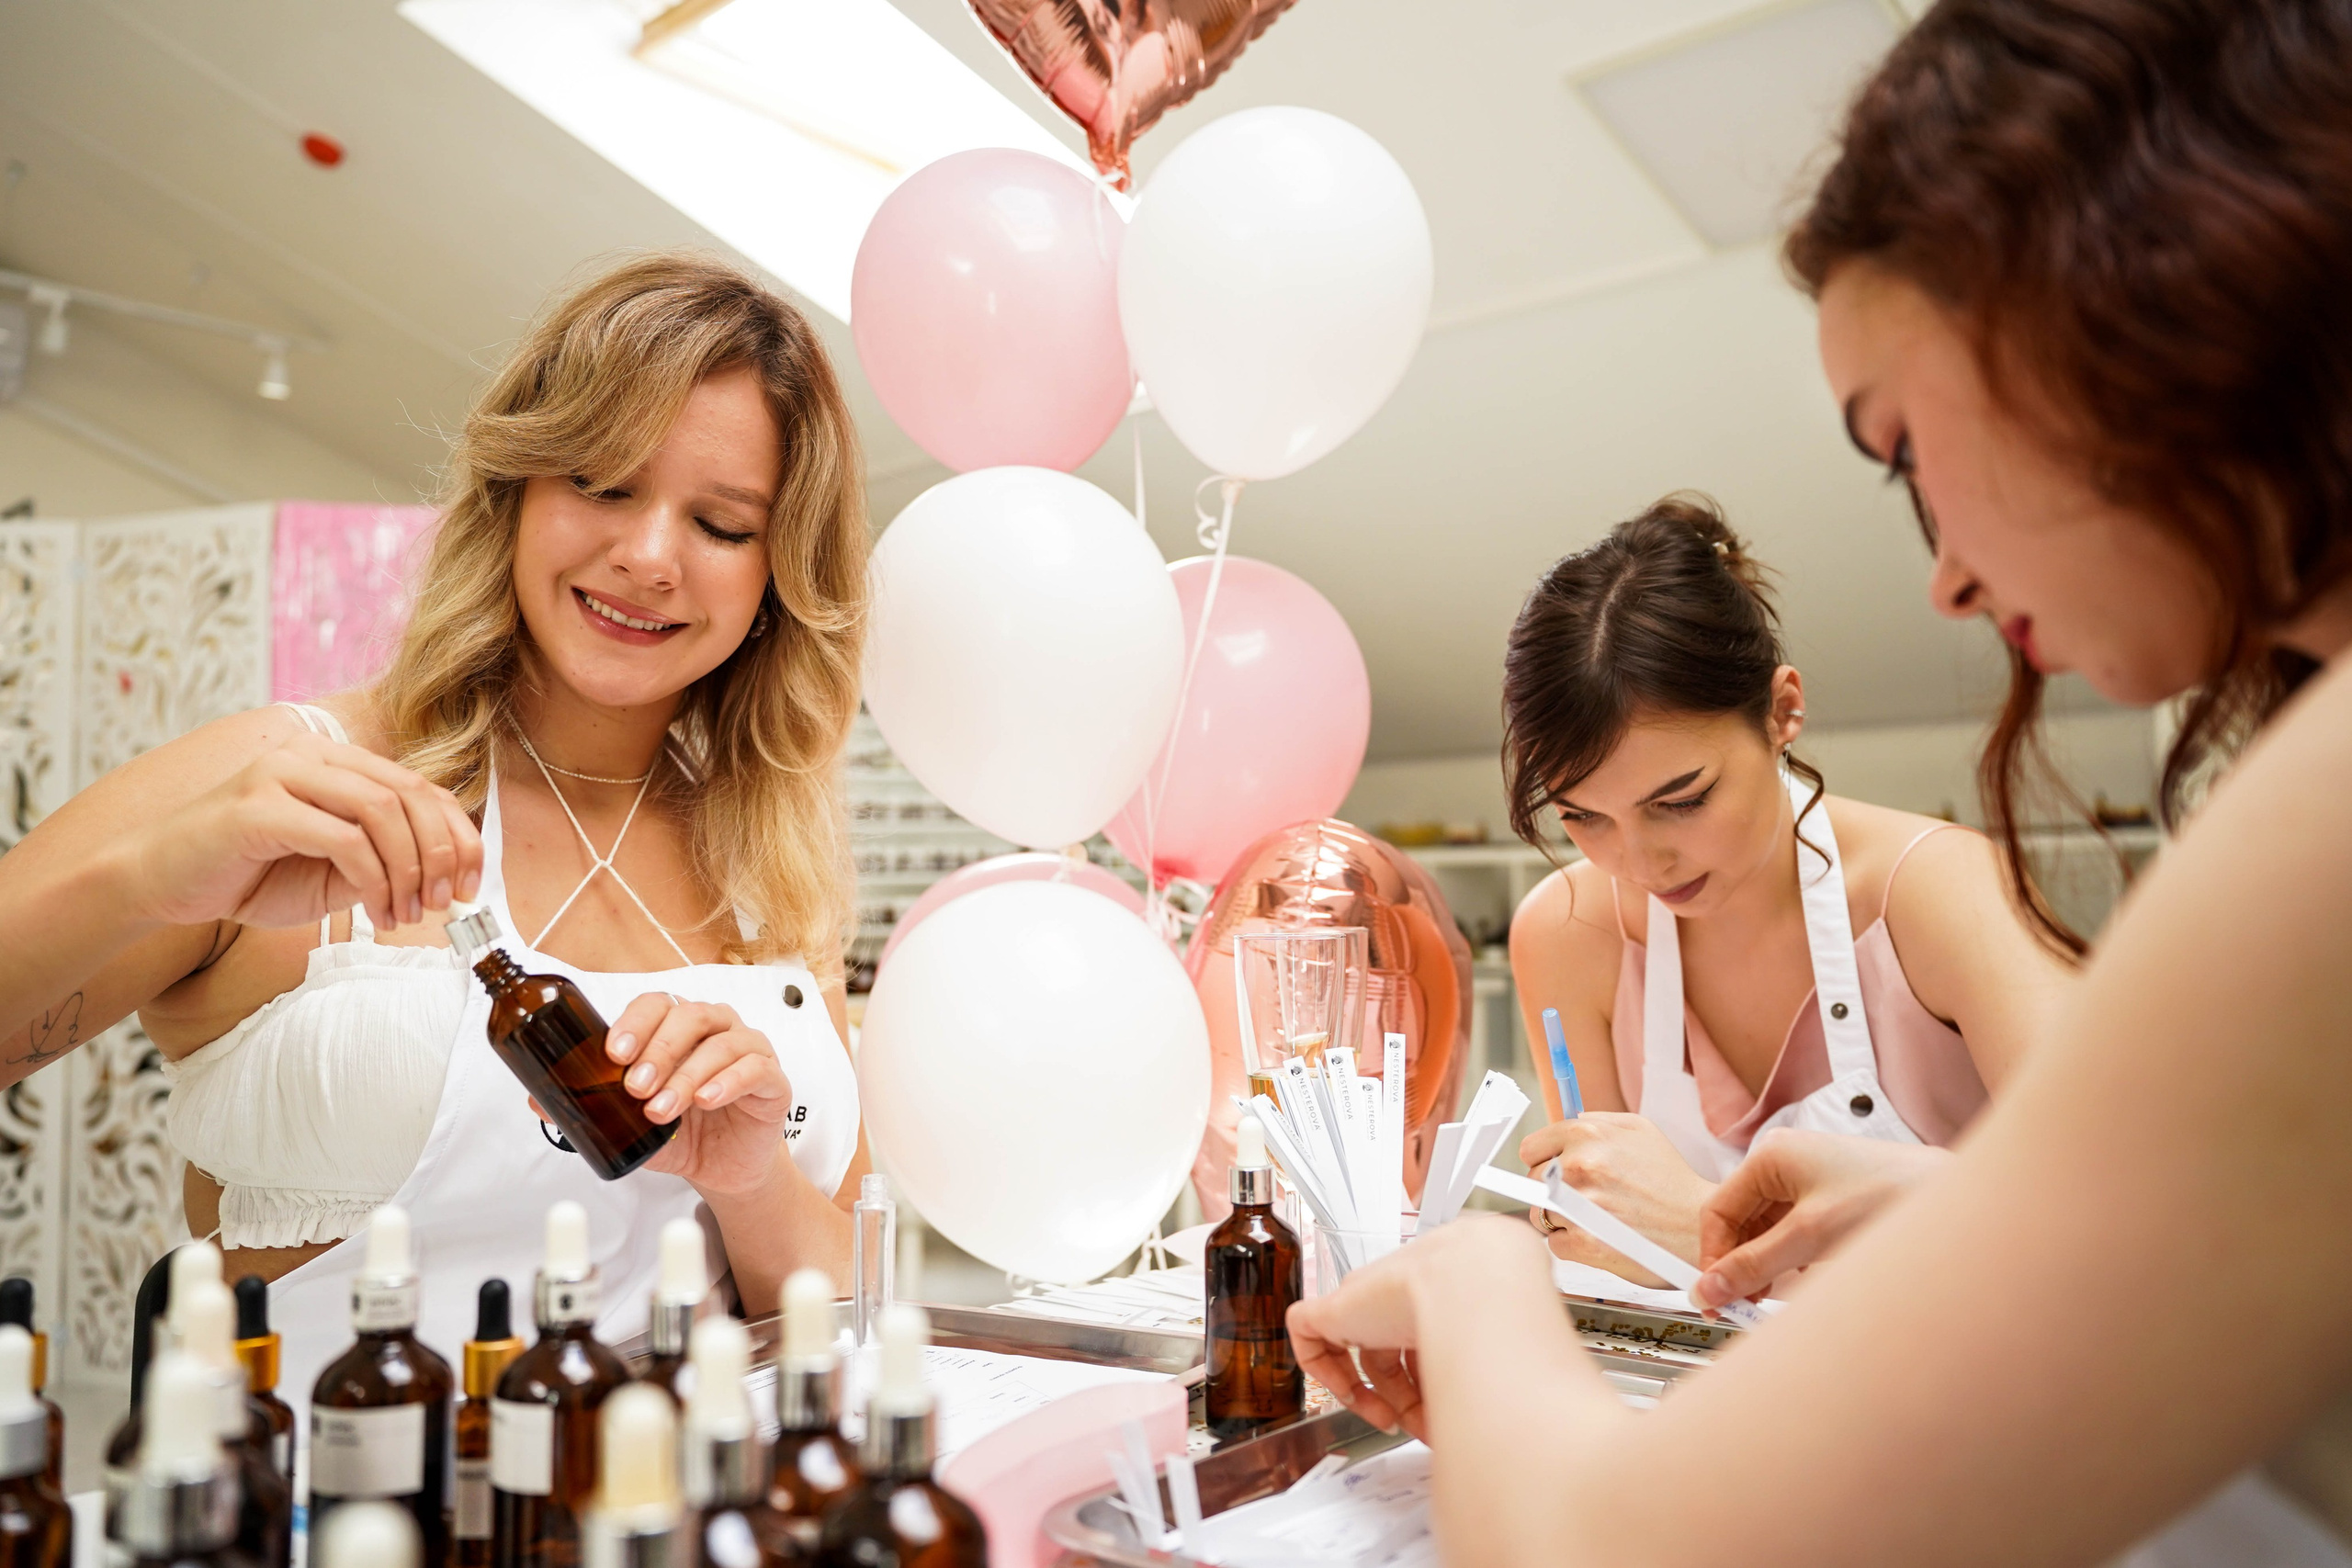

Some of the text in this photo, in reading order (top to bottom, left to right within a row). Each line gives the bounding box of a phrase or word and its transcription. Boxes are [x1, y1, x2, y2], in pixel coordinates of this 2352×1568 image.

[786, 1105, 808, 1122] AB
[1299, 1077, 1321, 1131] NESTEROVA
[1338, 1067, 1352, 1120] NESTEROVA
[1367, 1094, 1376, 1141] NESTEROVA
